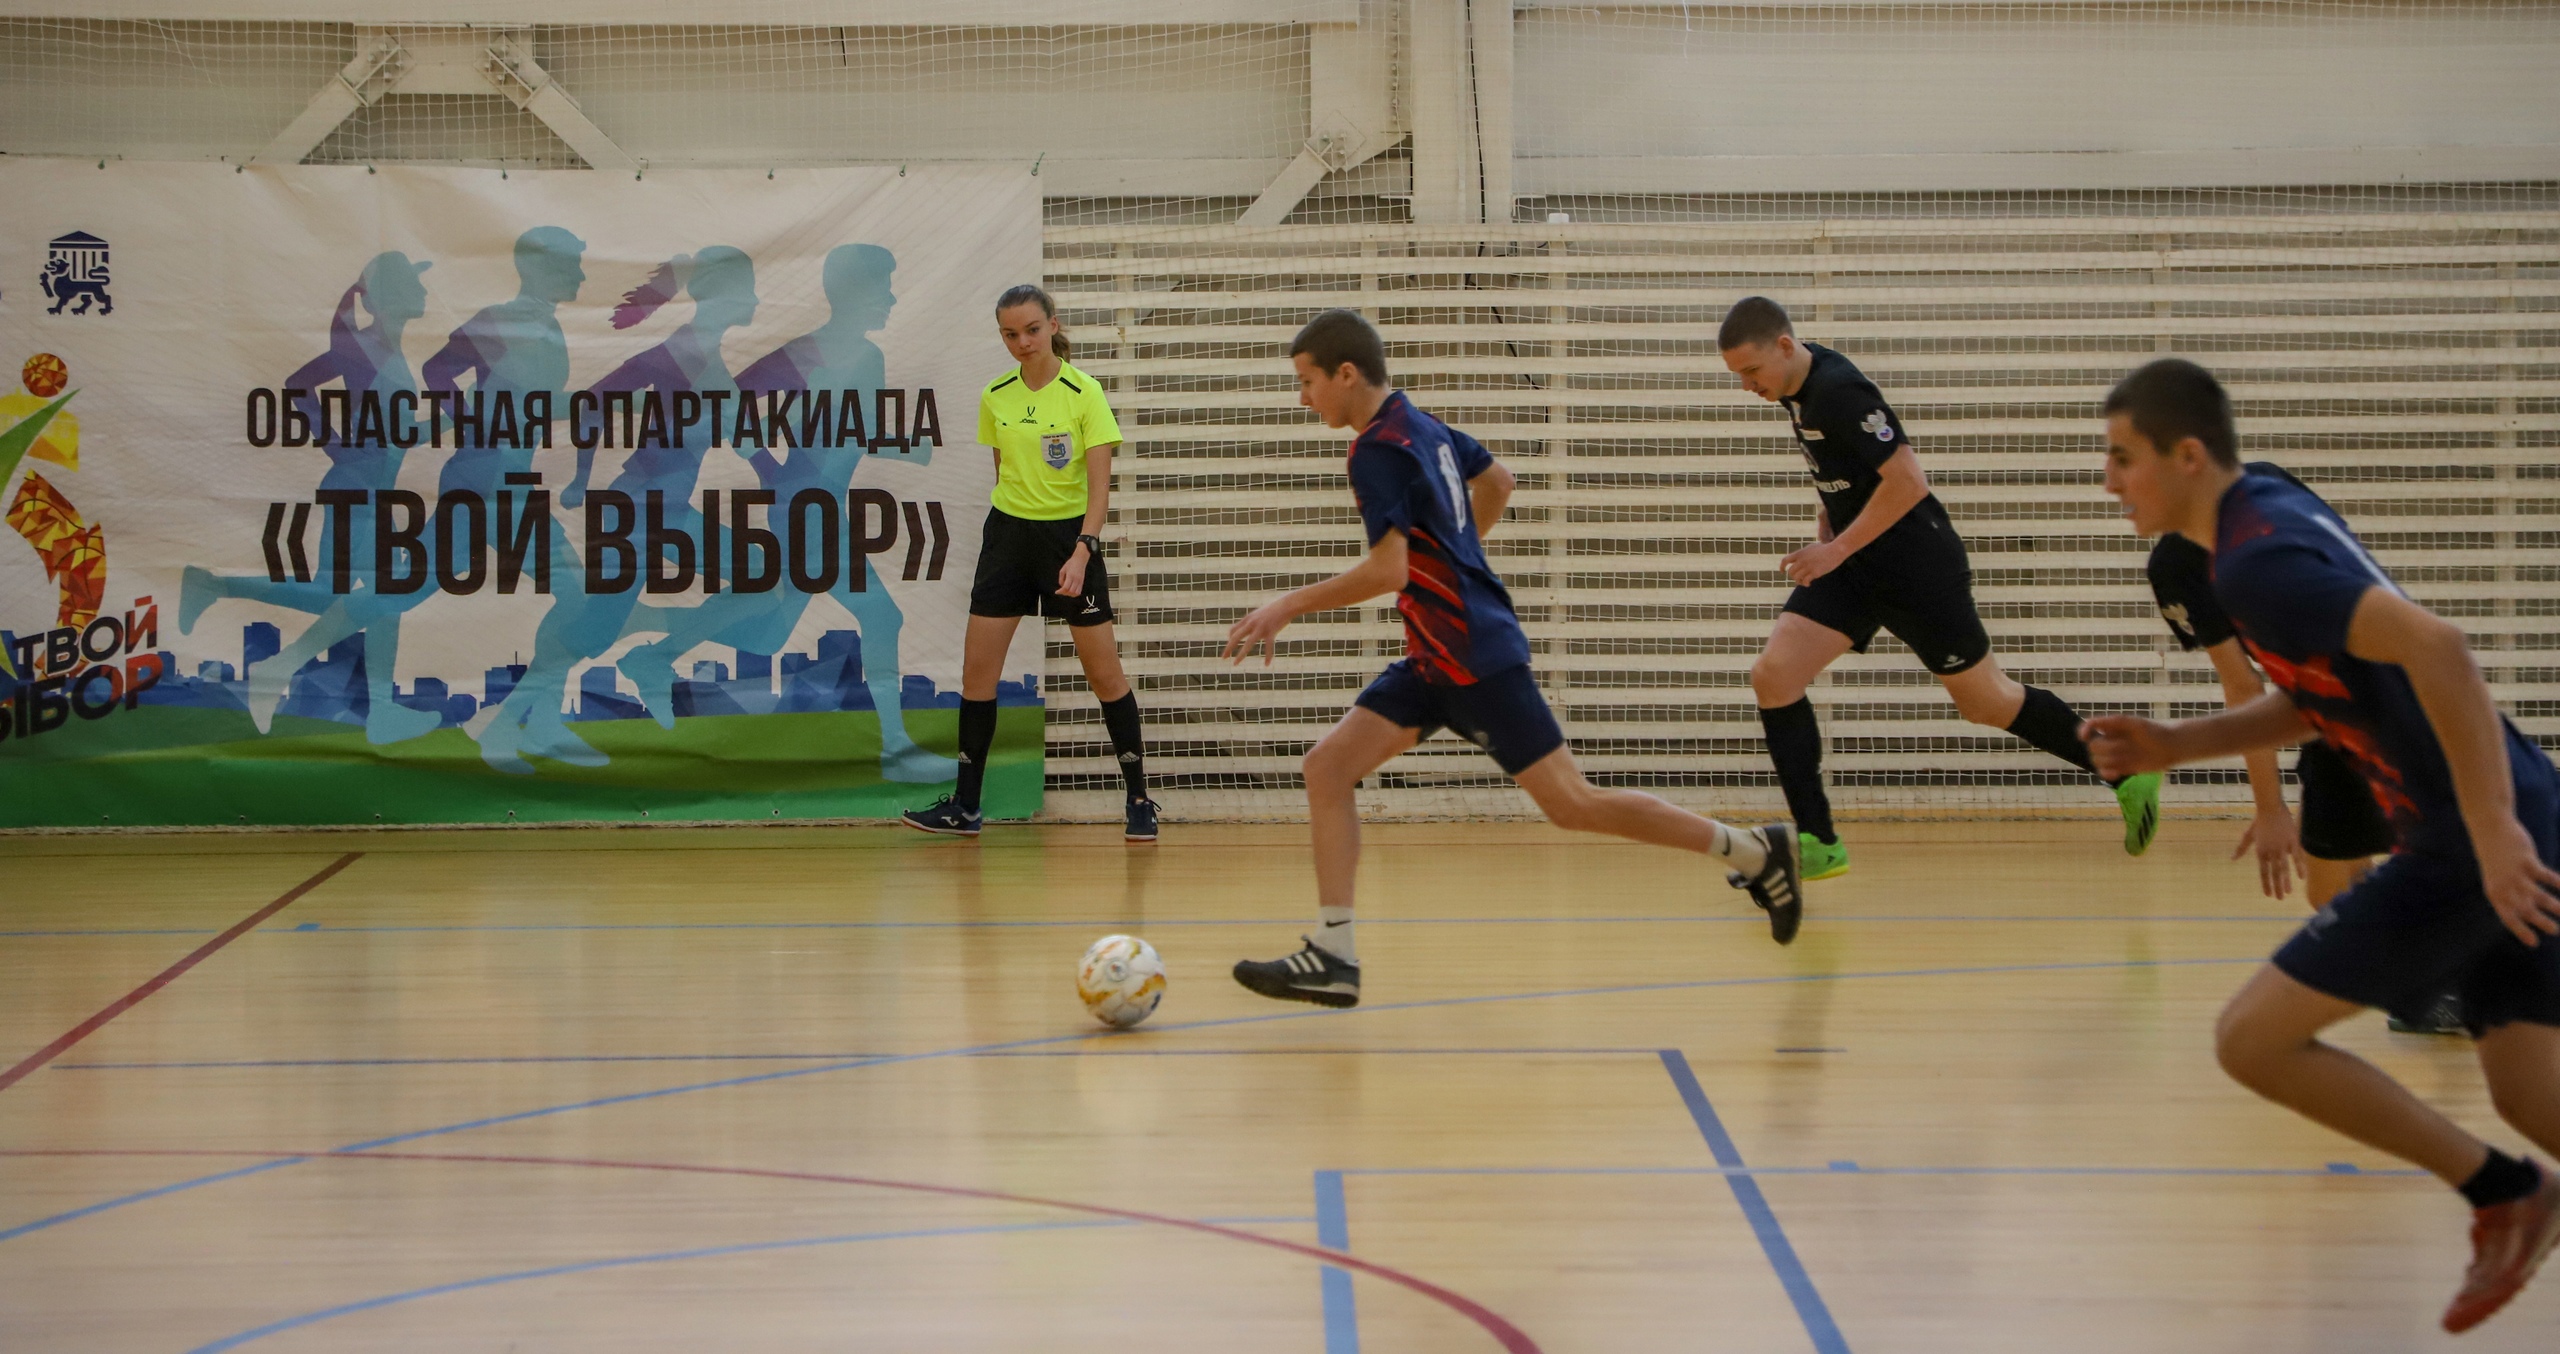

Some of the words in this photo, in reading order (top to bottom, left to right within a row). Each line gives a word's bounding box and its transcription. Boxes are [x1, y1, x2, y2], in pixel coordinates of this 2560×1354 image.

[247, 387, 552, 449] ОБЛАСТНАЯ
[569, 387, 942, 454] СПАРТАКИАДА
[261, 472, 550, 595] «ТВОЙ
[585, 488, 949, 595] ВЫБОР»
[12, 595, 158, 680] ТВОЙ
